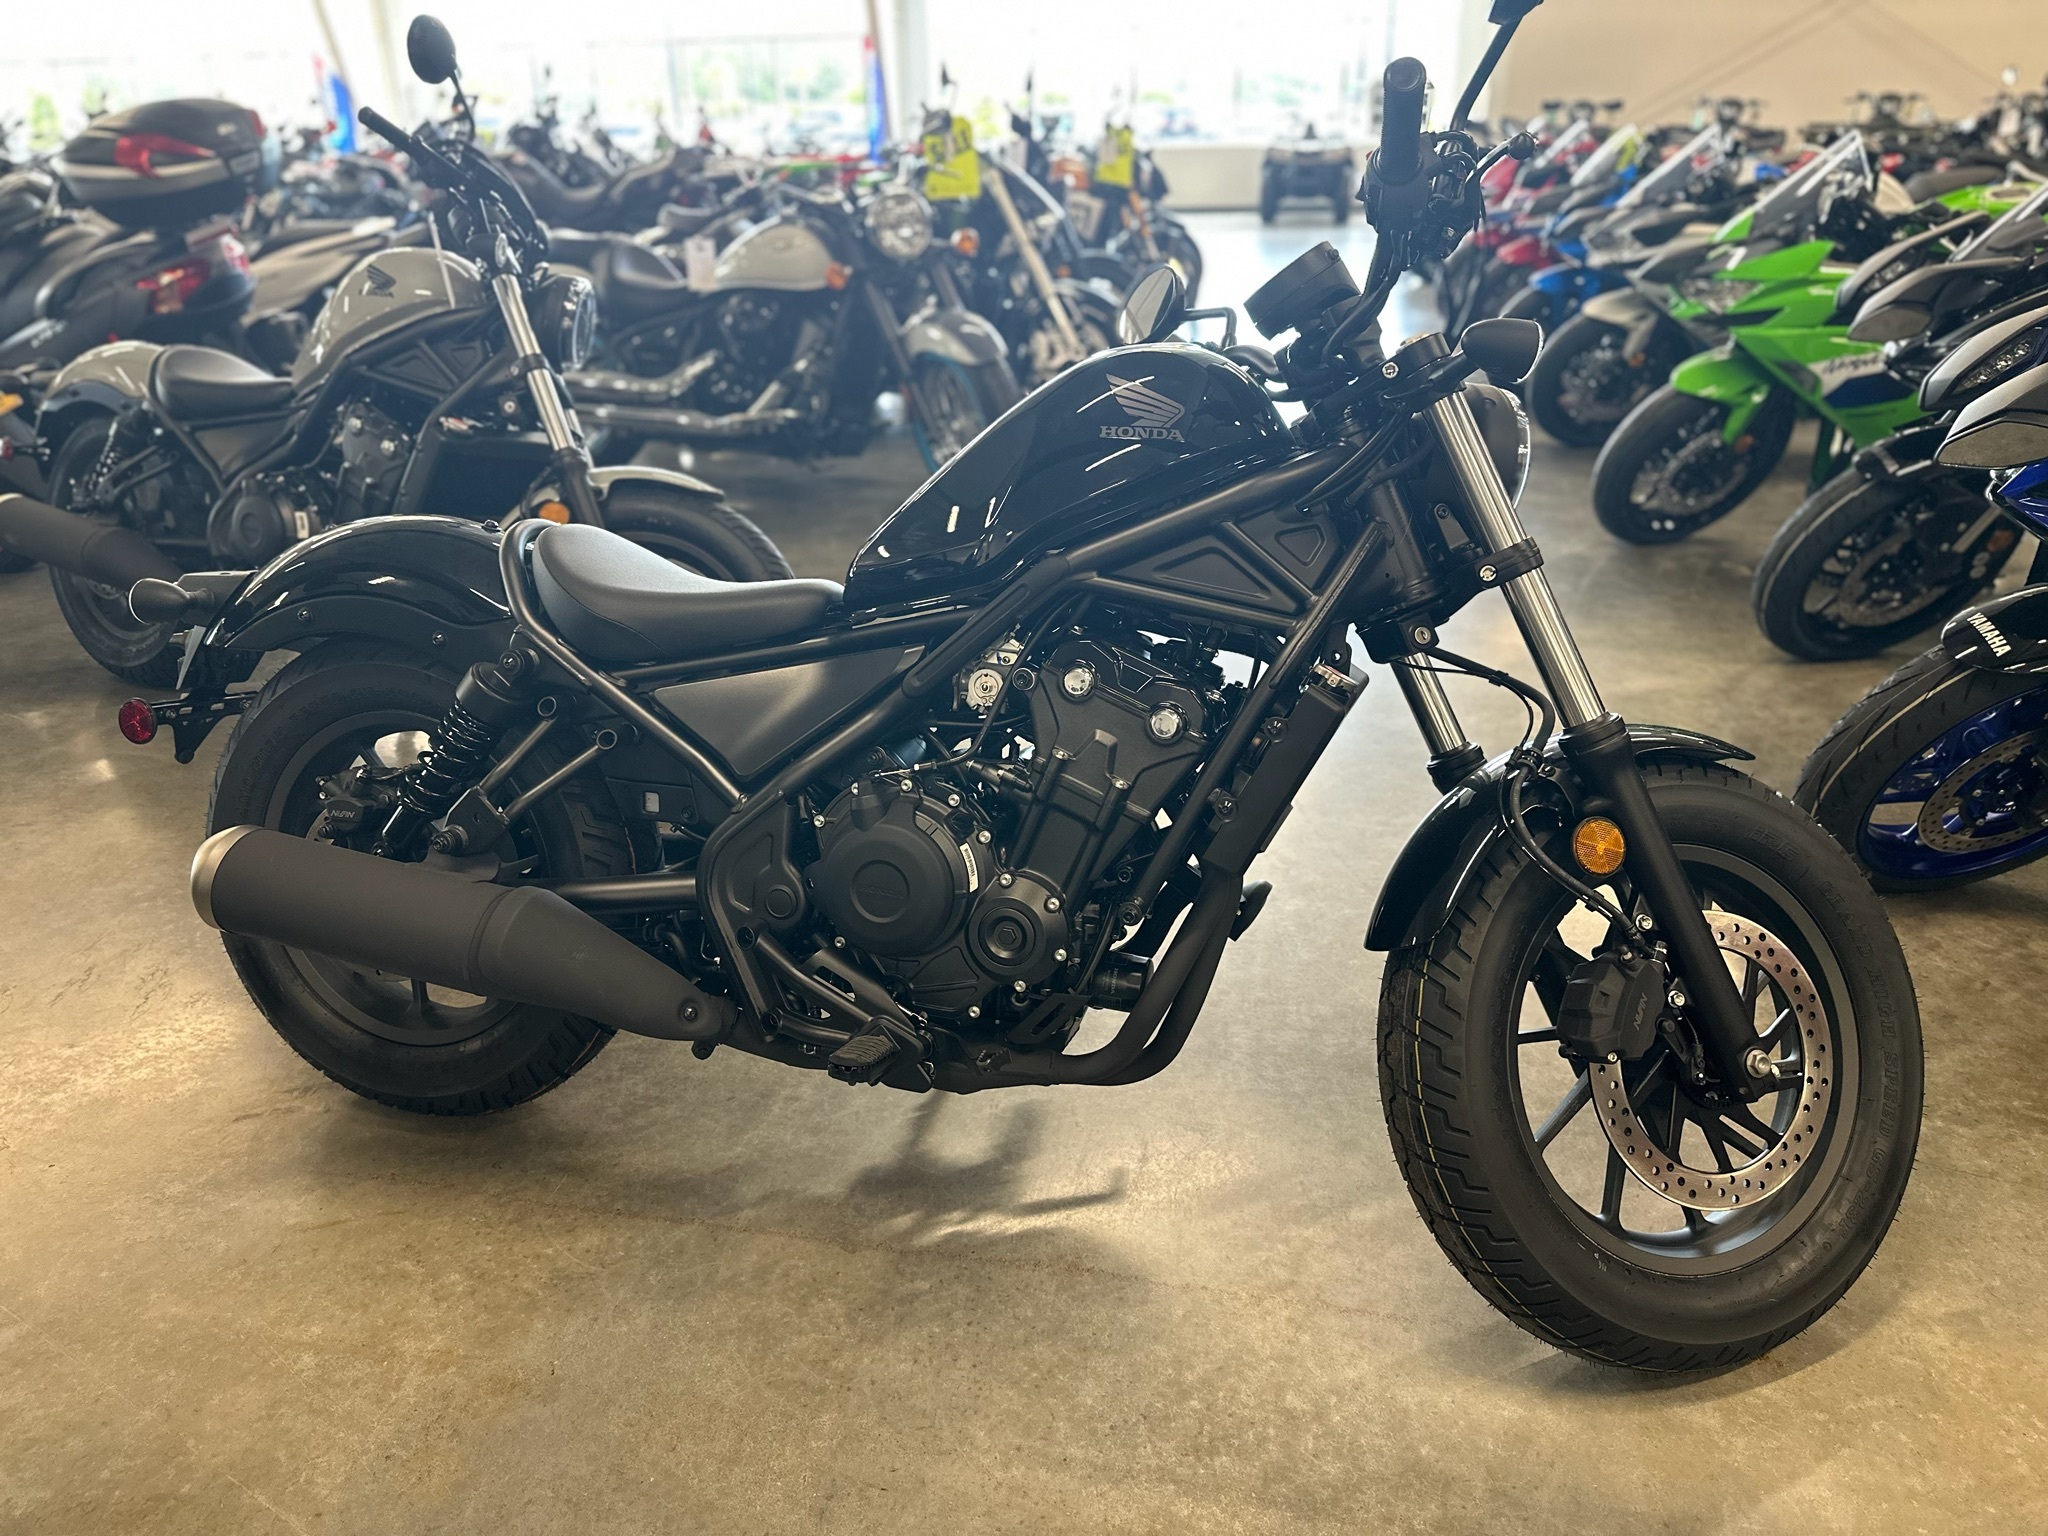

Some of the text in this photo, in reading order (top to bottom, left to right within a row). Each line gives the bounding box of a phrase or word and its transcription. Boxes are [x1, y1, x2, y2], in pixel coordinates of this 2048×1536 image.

[1100, 426, 1185, 442] HONDA
[1966, 612, 2012, 657] YAMAHA
[1818, 879, 1874, 960] GRAND
[1867, 964, 1896, 1039] HIGH
[1878, 1050, 1899, 1138] SPEED
